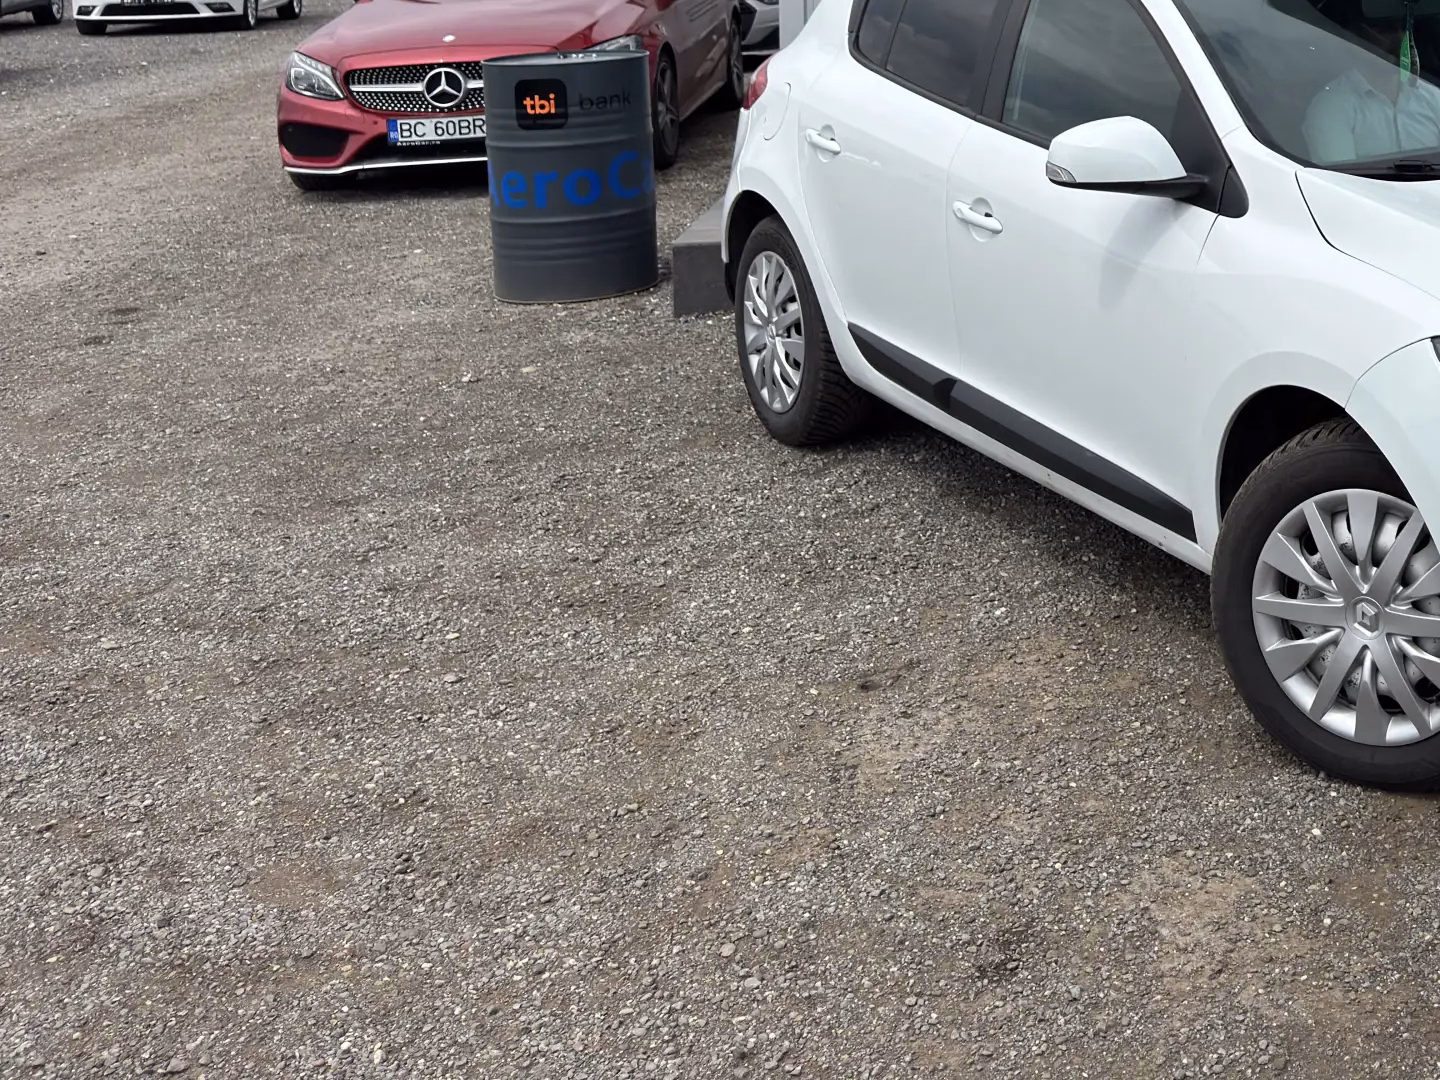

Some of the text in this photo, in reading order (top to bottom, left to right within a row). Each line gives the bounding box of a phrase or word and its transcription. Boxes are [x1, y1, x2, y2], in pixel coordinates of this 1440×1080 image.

[523, 88, 632, 115] tbi bank
[400, 121, 427, 139] BC
